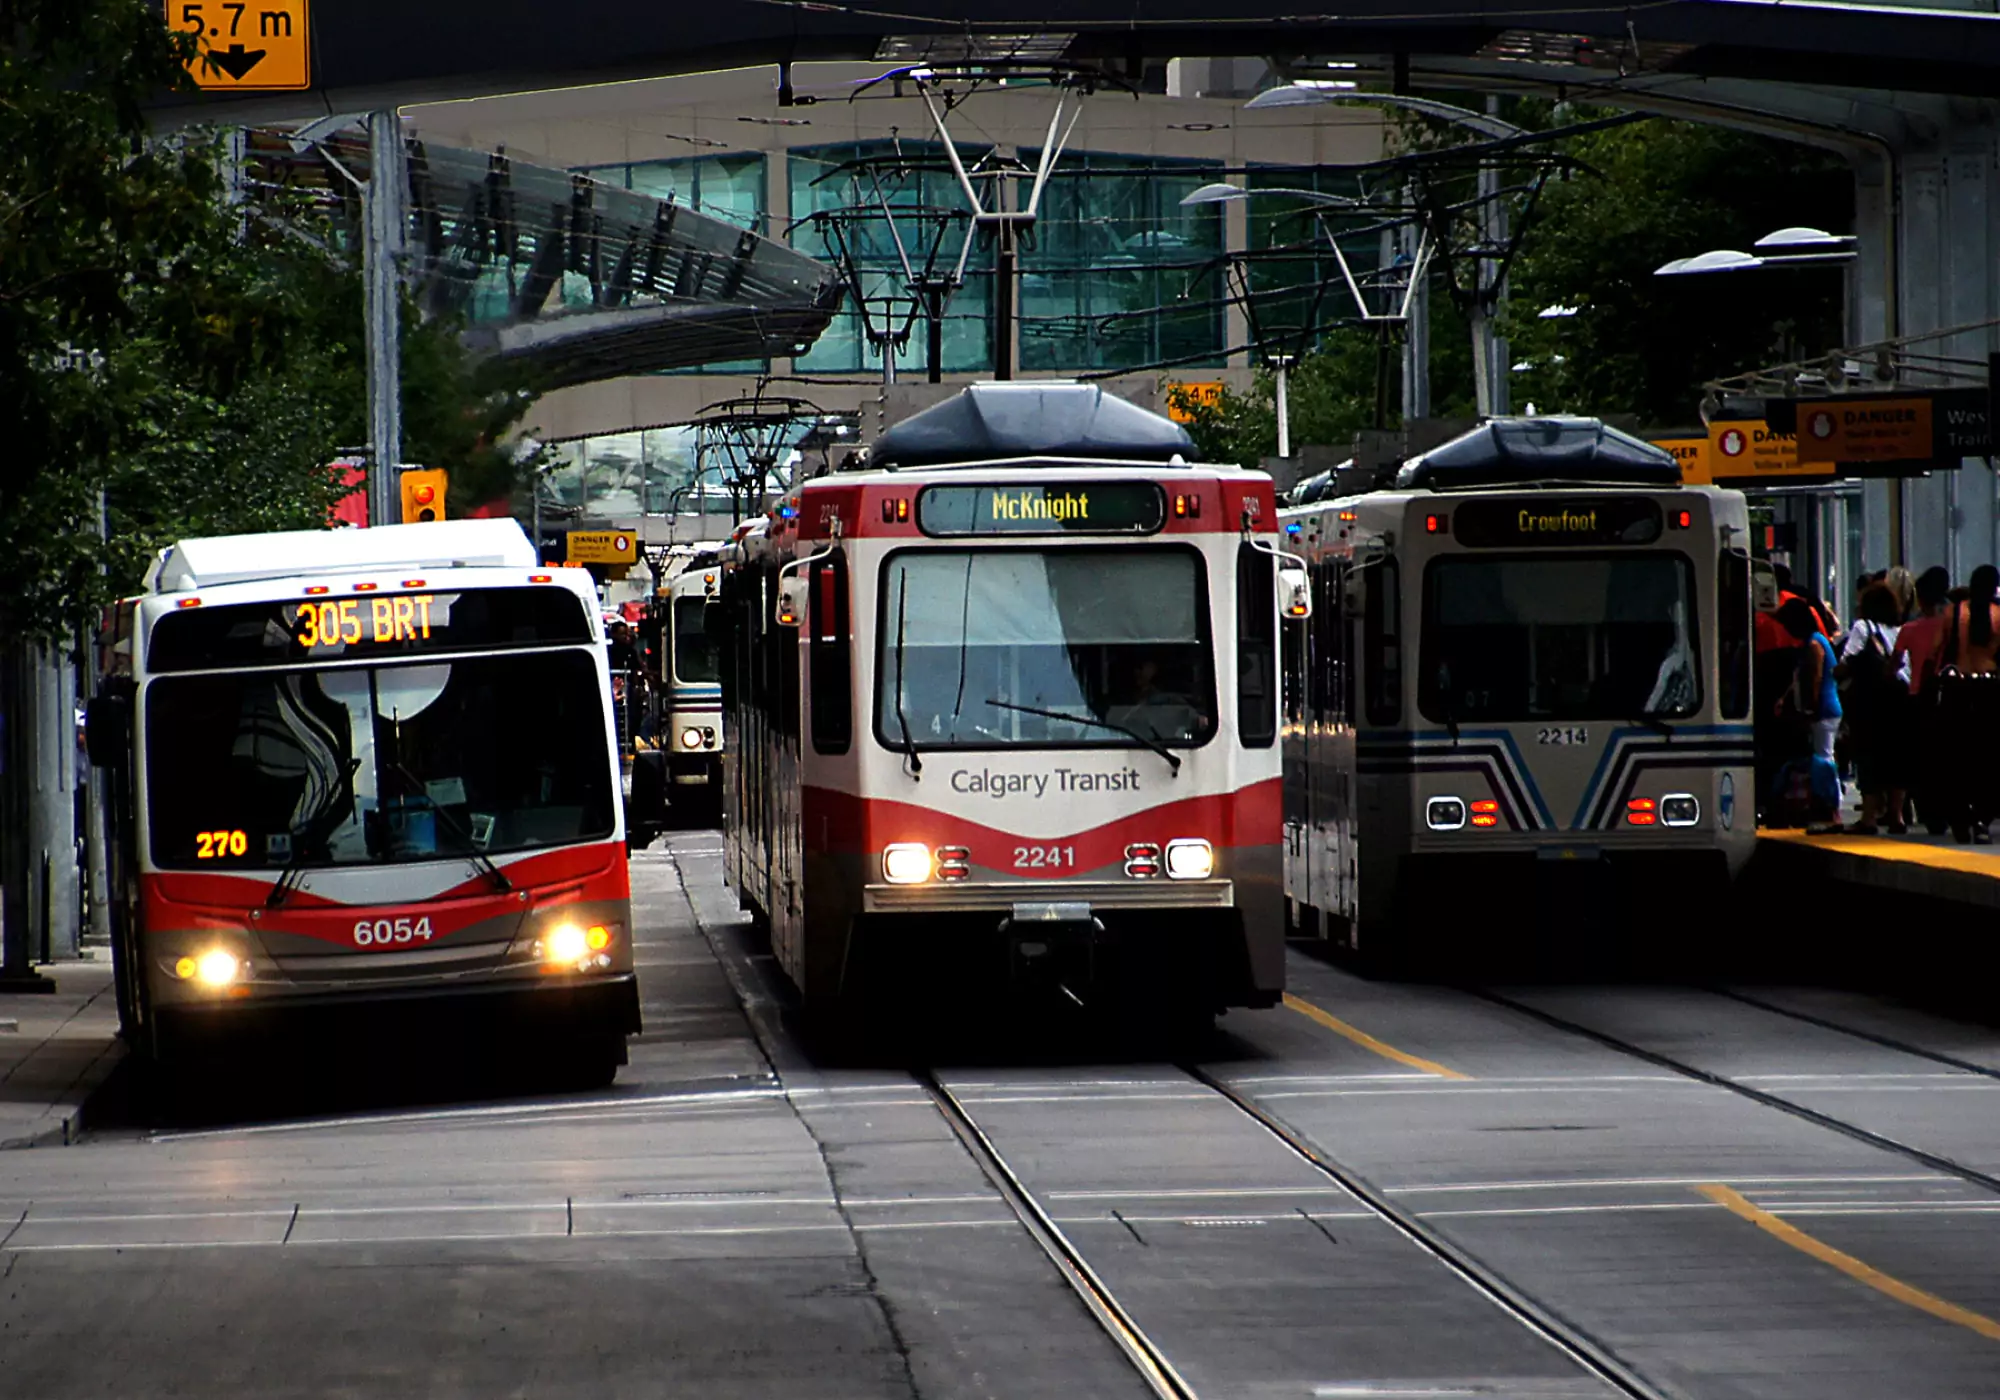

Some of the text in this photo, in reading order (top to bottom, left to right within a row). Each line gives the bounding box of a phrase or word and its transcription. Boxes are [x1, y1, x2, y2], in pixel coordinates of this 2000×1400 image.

[183, 3, 291, 37] 5.7 m
[1844, 408, 1917, 426] DANGER
[991, 491, 1089, 523] McKnight
[1517, 508, 1597, 533] Crowfoot
[296, 594, 434, 648] 305 BRT
[1537, 728, 1588, 745] 2214
[951, 766, 1141, 799] Calgary Transit
[196, 829, 248, 859] 270
[1013, 845, 1077, 869] 2241
[353, 915, 433, 946] 6054
